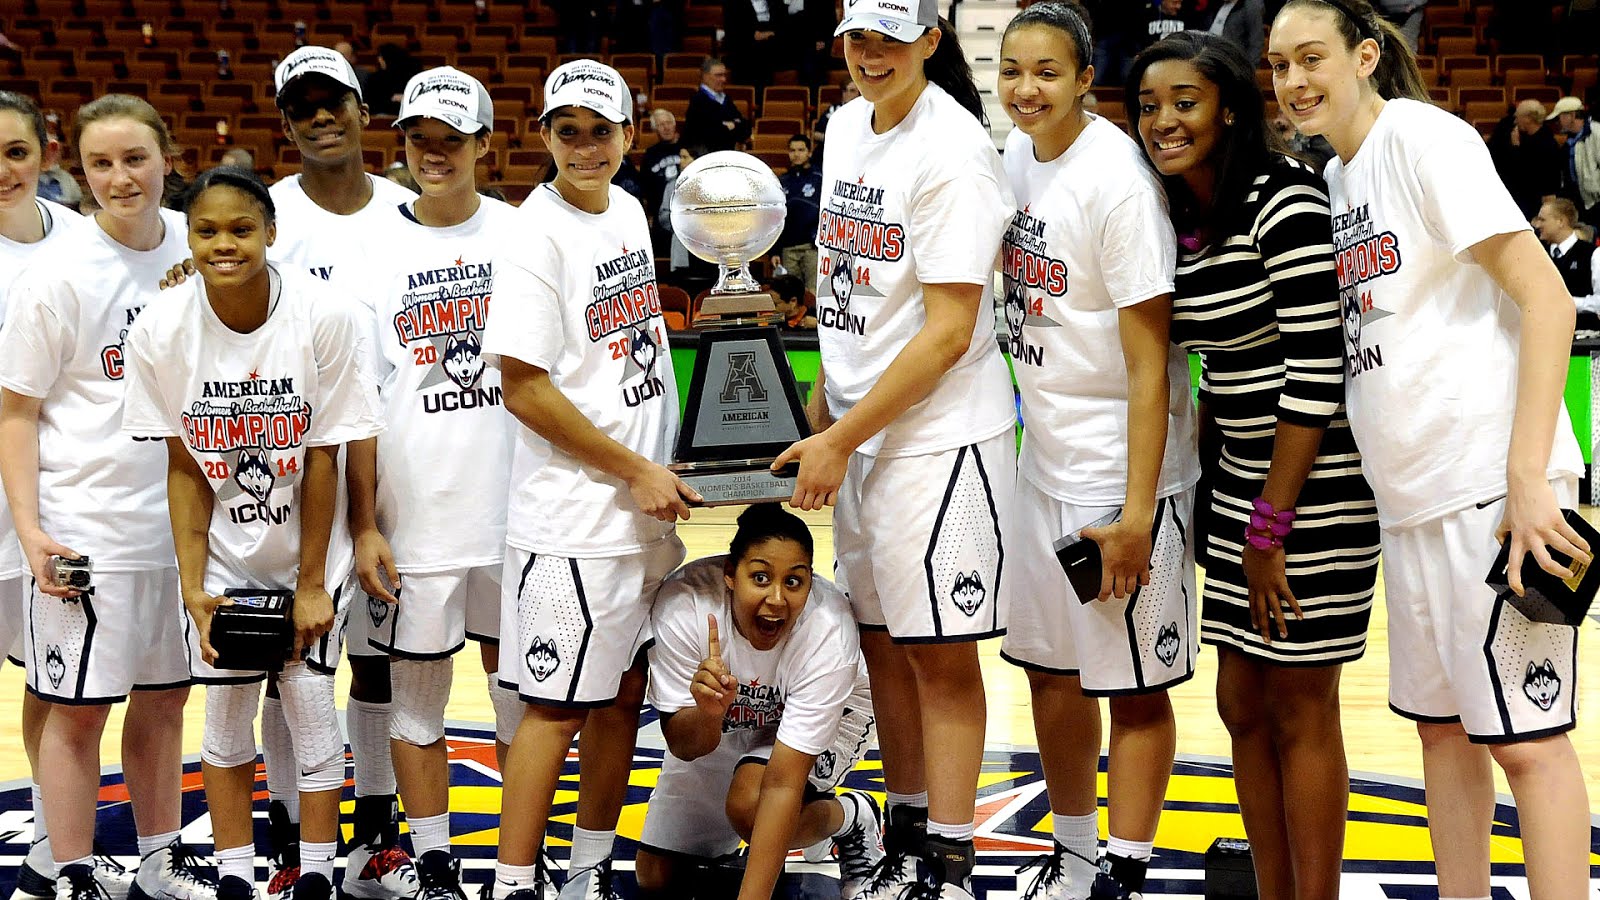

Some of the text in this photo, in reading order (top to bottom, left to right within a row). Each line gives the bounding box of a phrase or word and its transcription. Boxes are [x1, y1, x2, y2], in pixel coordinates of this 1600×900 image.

[552, 71, 615, 95] Champions
[439, 98, 468, 111] UCONN
[584, 87, 613, 101] UCONN
[819, 208, 905, 262] CAMPIONS
[596, 249, 650, 282] AMERICAN
[1334, 231, 1401, 292] MPIONS
[856, 266, 870, 285] 14
[402, 286, 450, 310] Women's
[1028, 296, 1044, 316] 14
[1361, 290, 1374, 313] 14
[413, 345, 437, 366] 20
[608, 337, 630, 360] 20
[202, 377, 294, 399] AMERICAN
[192, 396, 301, 416] Women's Basketball
[722, 411, 769, 422] AMERICAN
[204, 456, 298, 480] 20 14
[699, 480, 789, 494] WOMEN'S BASKETBALL
[732, 475, 752, 484] 2014
[722, 489, 765, 499] CHAMPION
